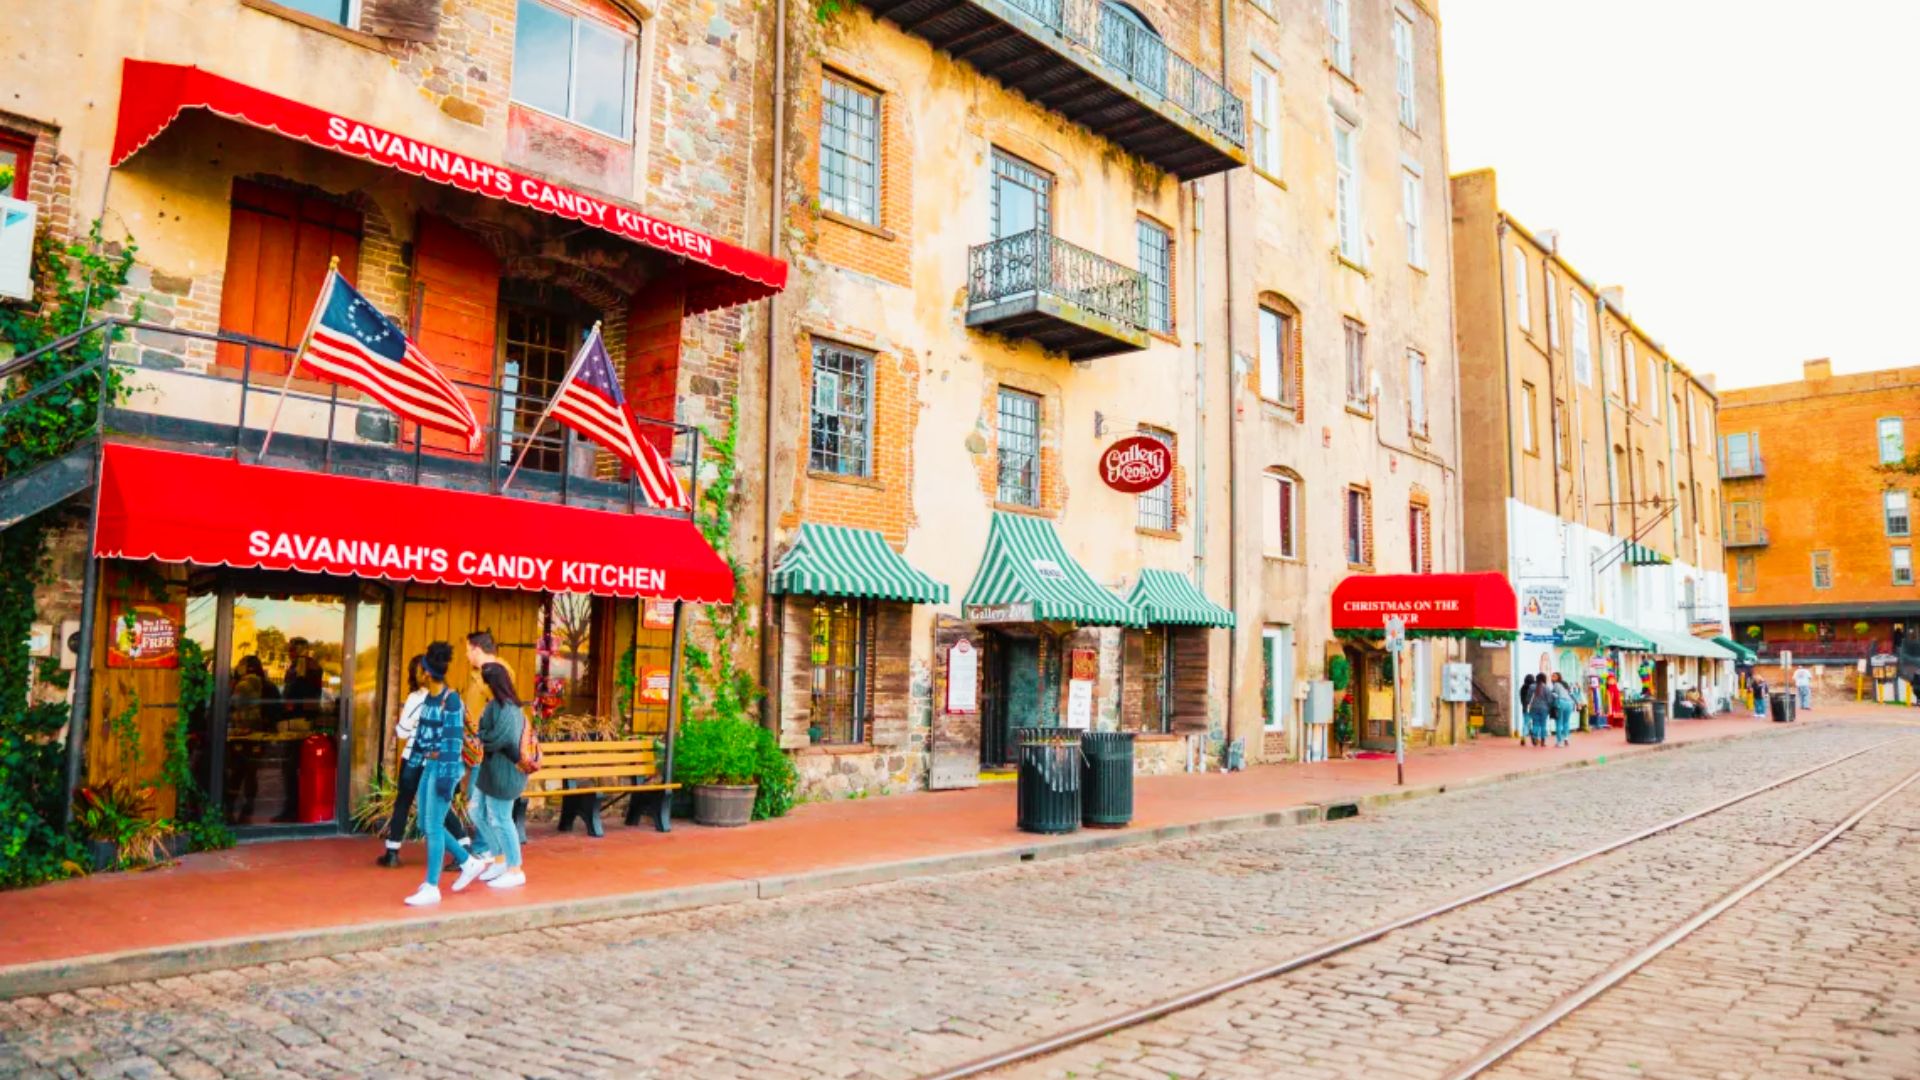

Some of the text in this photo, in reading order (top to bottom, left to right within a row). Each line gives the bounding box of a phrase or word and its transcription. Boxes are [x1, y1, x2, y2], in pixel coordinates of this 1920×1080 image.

[327, 116, 713, 257] SAVANNAH'S CANDY KITCHEN
[1106, 444, 1165, 482] Gallery
[248, 530, 666, 591] SAVANNAH'S CANDY KITCHEN
[971, 607, 1009, 622] Gallery
[1343, 600, 1459, 611] CHRISTMAS ON THE
[142, 637, 174, 648] FREE
